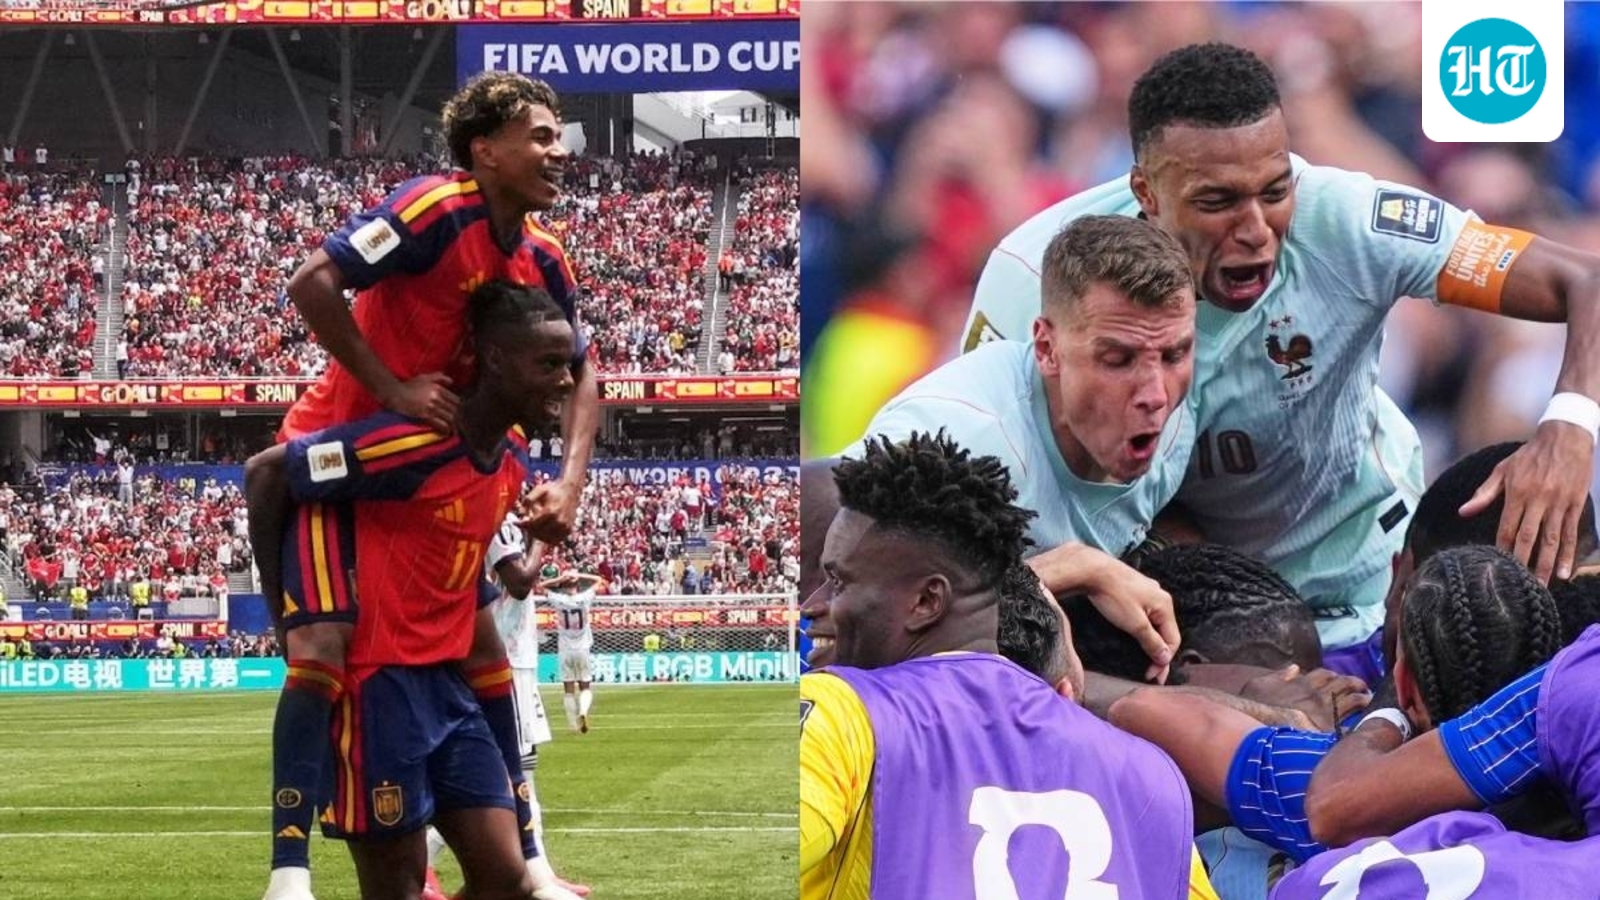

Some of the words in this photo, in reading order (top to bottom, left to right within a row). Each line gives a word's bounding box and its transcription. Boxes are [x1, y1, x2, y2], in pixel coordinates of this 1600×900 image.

[140, 10, 164, 22] SPAIN
[583, 0, 630, 19] SPAIN
[483, 43, 569, 74] FIFA
[575, 42, 720, 74] WORLD
[727, 40, 800, 73] CUP
[1456, 229, 1495, 282] UNITES
[101, 384, 157, 403] GOAL!
[255, 384, 296, 402] SPAIN
[604, 381, 645, 399] SPAIN
[1197, 429, 1258, 478] 10
[445, 541, 481, 591] 17
[562, 608, 584, 630] 17
[45, 623, 87, 638] GOAL!
[162, 623, 194, 637] SPAIN
[147, 658, 272, 688] 世界第一
[653, 654, 715, 680] RGB
